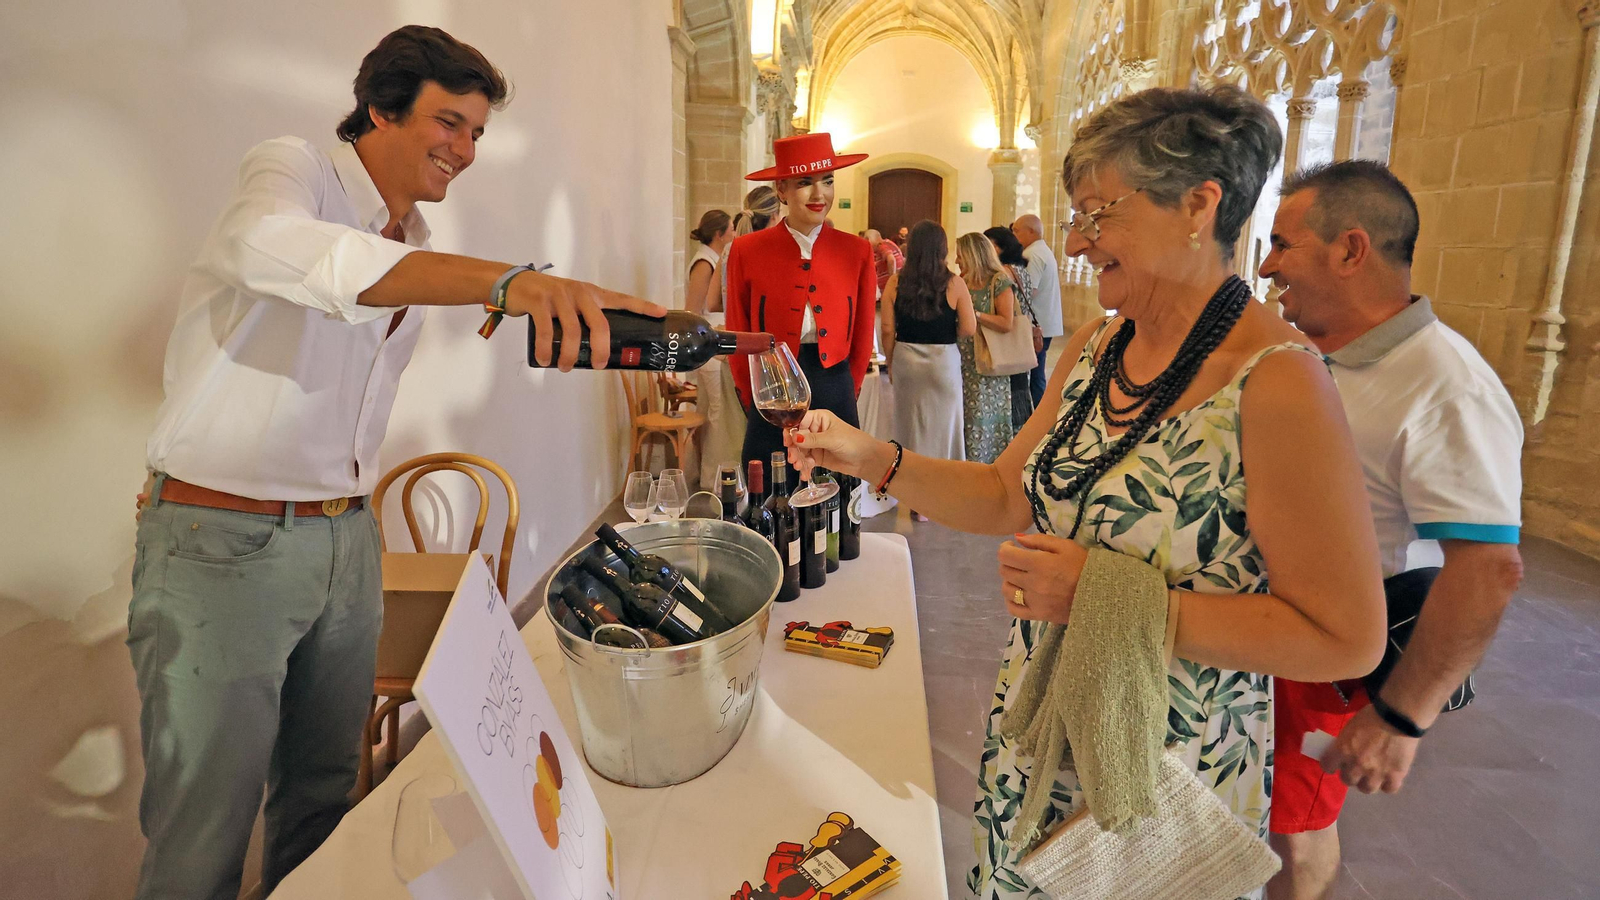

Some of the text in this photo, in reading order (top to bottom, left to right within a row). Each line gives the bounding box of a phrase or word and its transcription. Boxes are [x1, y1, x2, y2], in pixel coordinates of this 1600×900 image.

[789, 158, 833, 174] TIO PEPE
[657, 598, 670, 613] TIO
[476, 629, 514, 757] GONZALEZ
[499, 675, 523, 758] BYASS
